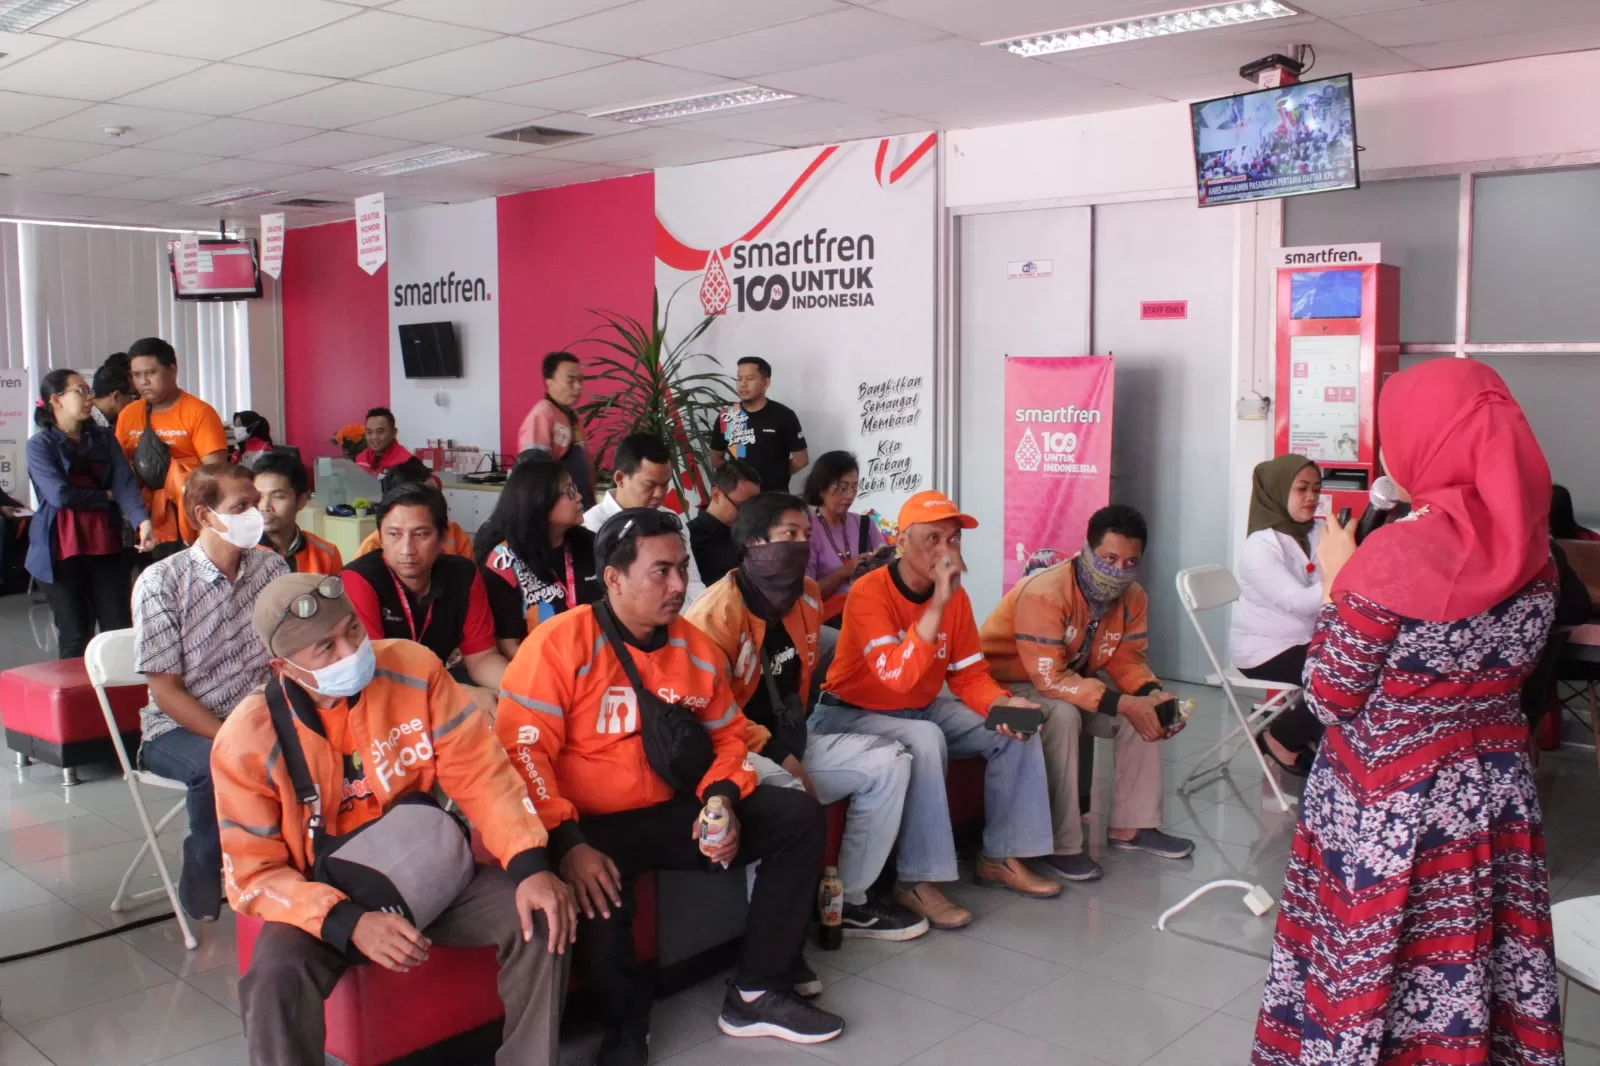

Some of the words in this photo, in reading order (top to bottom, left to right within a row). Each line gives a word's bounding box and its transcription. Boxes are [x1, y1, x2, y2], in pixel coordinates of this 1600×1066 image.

[1249, 178, 1278, 191] PASANGAN
[1277, 175, 1301, 188] PERTAMA
[1302, 173, 1323, 185] DAFTAR
[1324, 171, 1335, 181] KPU
[733, 228, 875, 269] smartfren
[791, 267, 874, 292] UNTUK
[792, 293, 875, 309] INDONESIA
[1165, 305, 1186, 313] ONLY
[858, 376, 922, 400] Bangkitkan
[860, 393, 919, 417] Semangat
[1015, 405, 1101, 423] smartfren
[861, 409, 921, 435] Membara!
[877, 440, 901, 457] Kita
[1044, 453, 1075, 463] UNTUK
[867, 457, 911, 477] Terbang
[1043, 463, 1098, 474] INDONESIA
[857, 477, 885, 497] Lebih
[890, 472, 921, 491] Tinggi
[375, 731, 433, 793] Food
